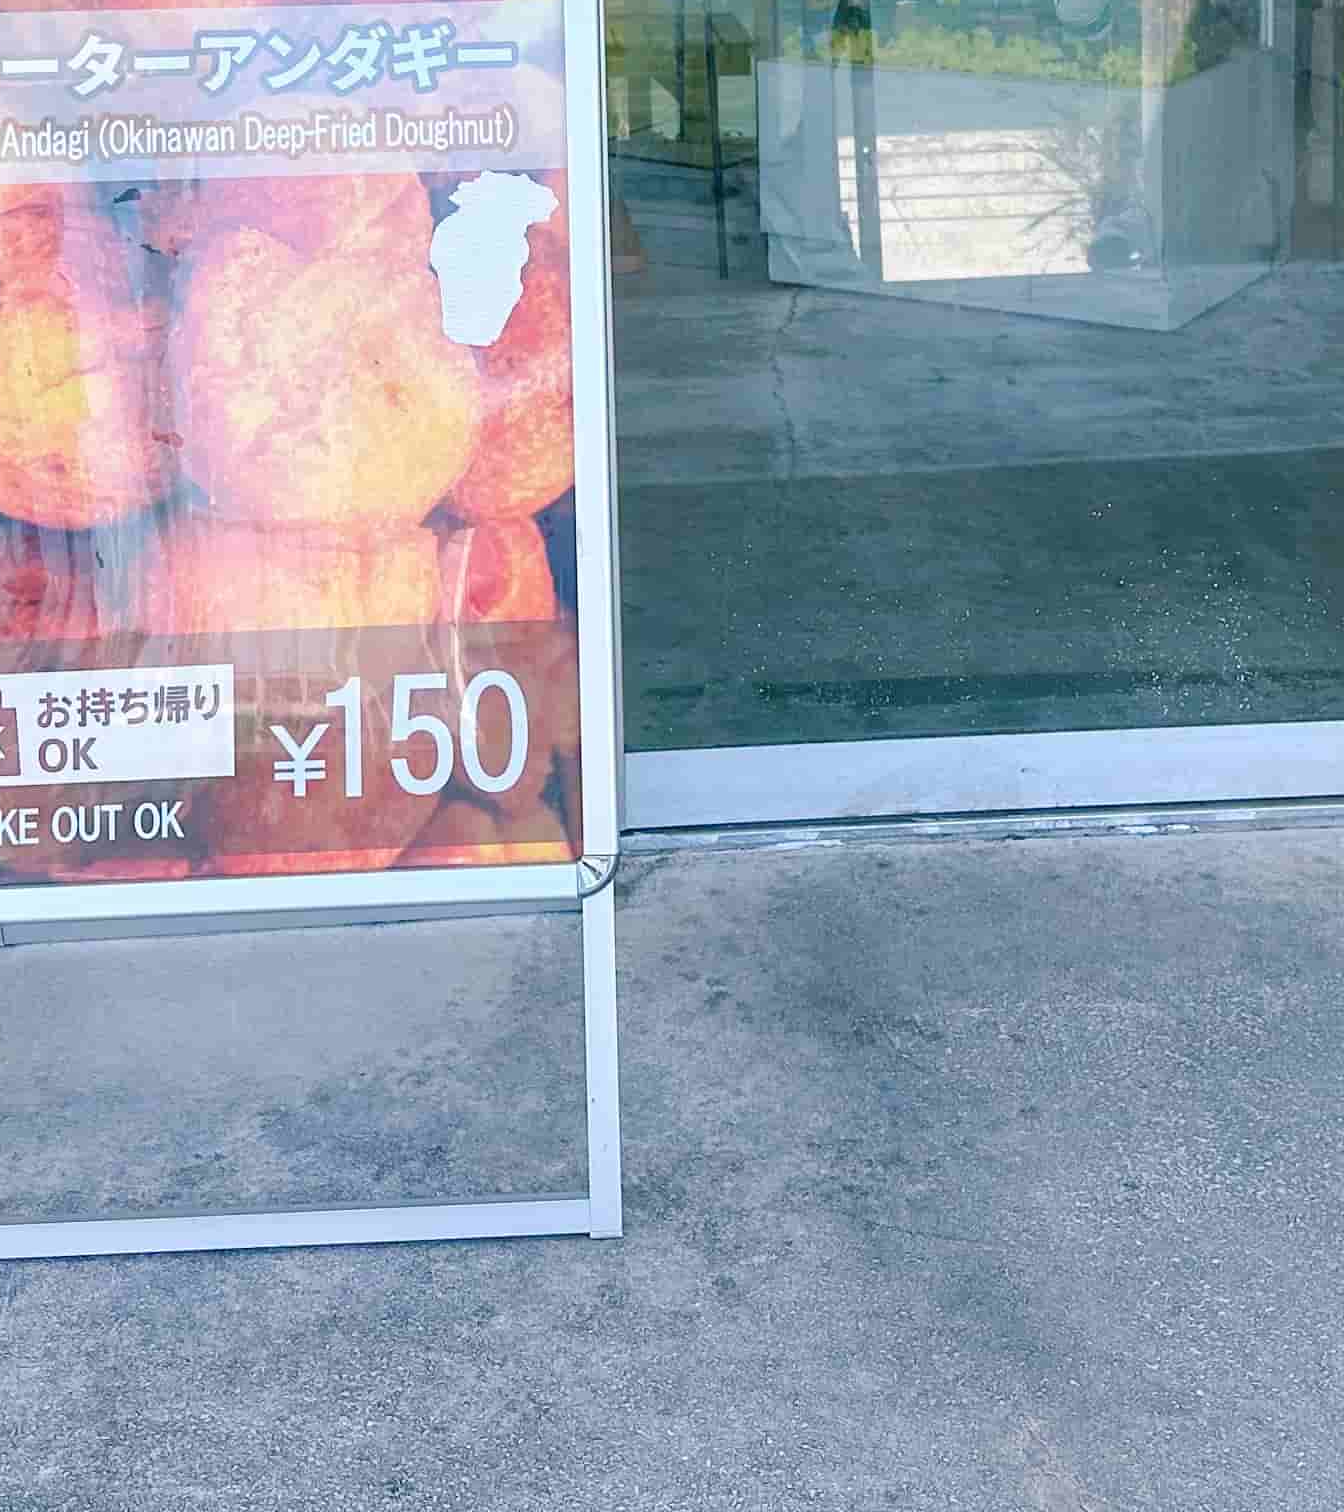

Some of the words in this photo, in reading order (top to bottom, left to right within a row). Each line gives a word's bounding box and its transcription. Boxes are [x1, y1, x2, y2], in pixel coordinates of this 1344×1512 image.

[0, 121, 90, 162] Andagi
[99, 117, 236, 160] (Okinawan
[245, 111, 377, 156] Deep-Fried
[386, 106, 515, 156] Doughnut)
[35, 683, 224, 731] お持ち帰り
[37, 734, 100, 774] OK
[50, 804, 119, 844] OUT
[133, 800, 186, 840] OK
